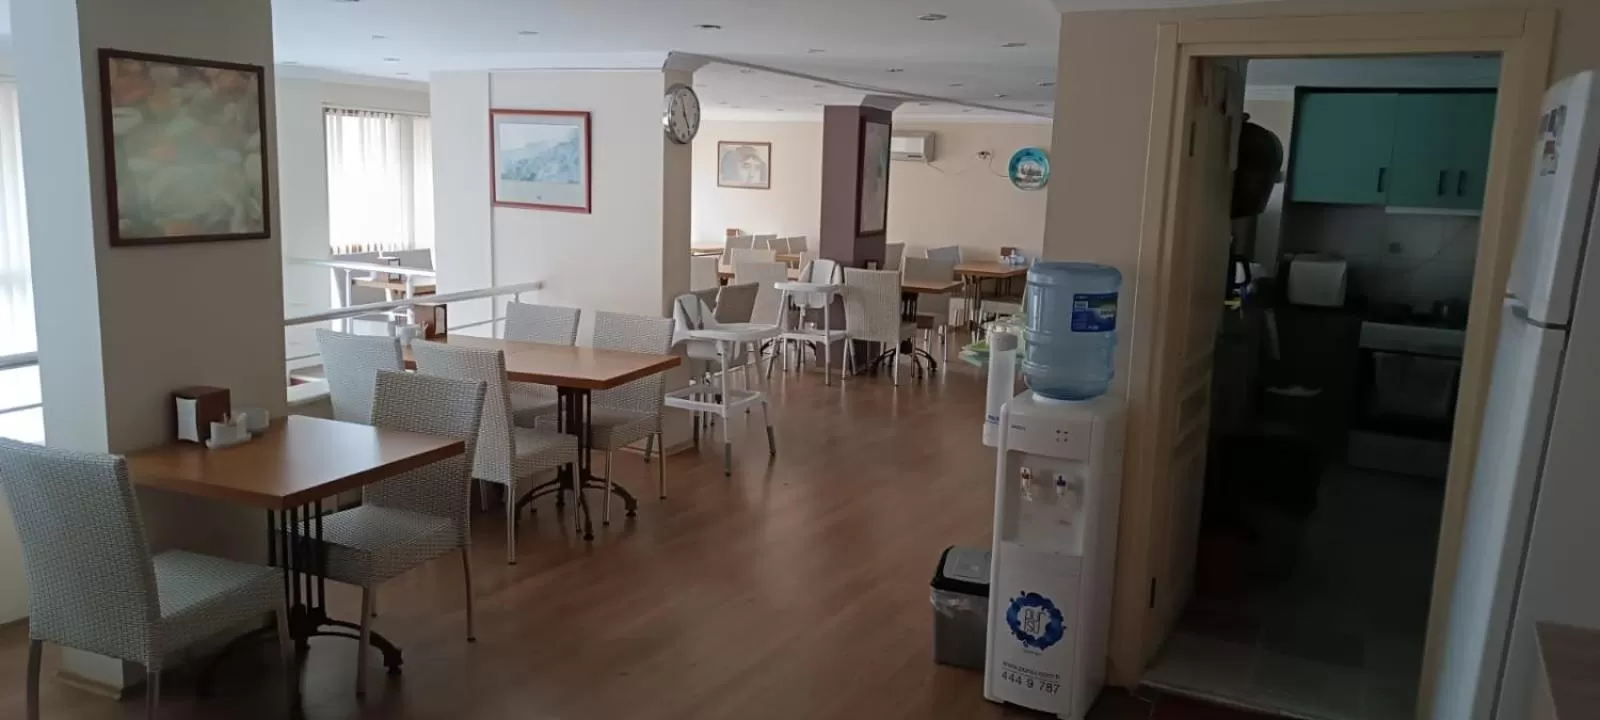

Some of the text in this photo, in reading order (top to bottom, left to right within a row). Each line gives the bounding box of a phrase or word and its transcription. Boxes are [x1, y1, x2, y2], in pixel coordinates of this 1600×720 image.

[1001, 671, 1061, 695] 444 9 787
